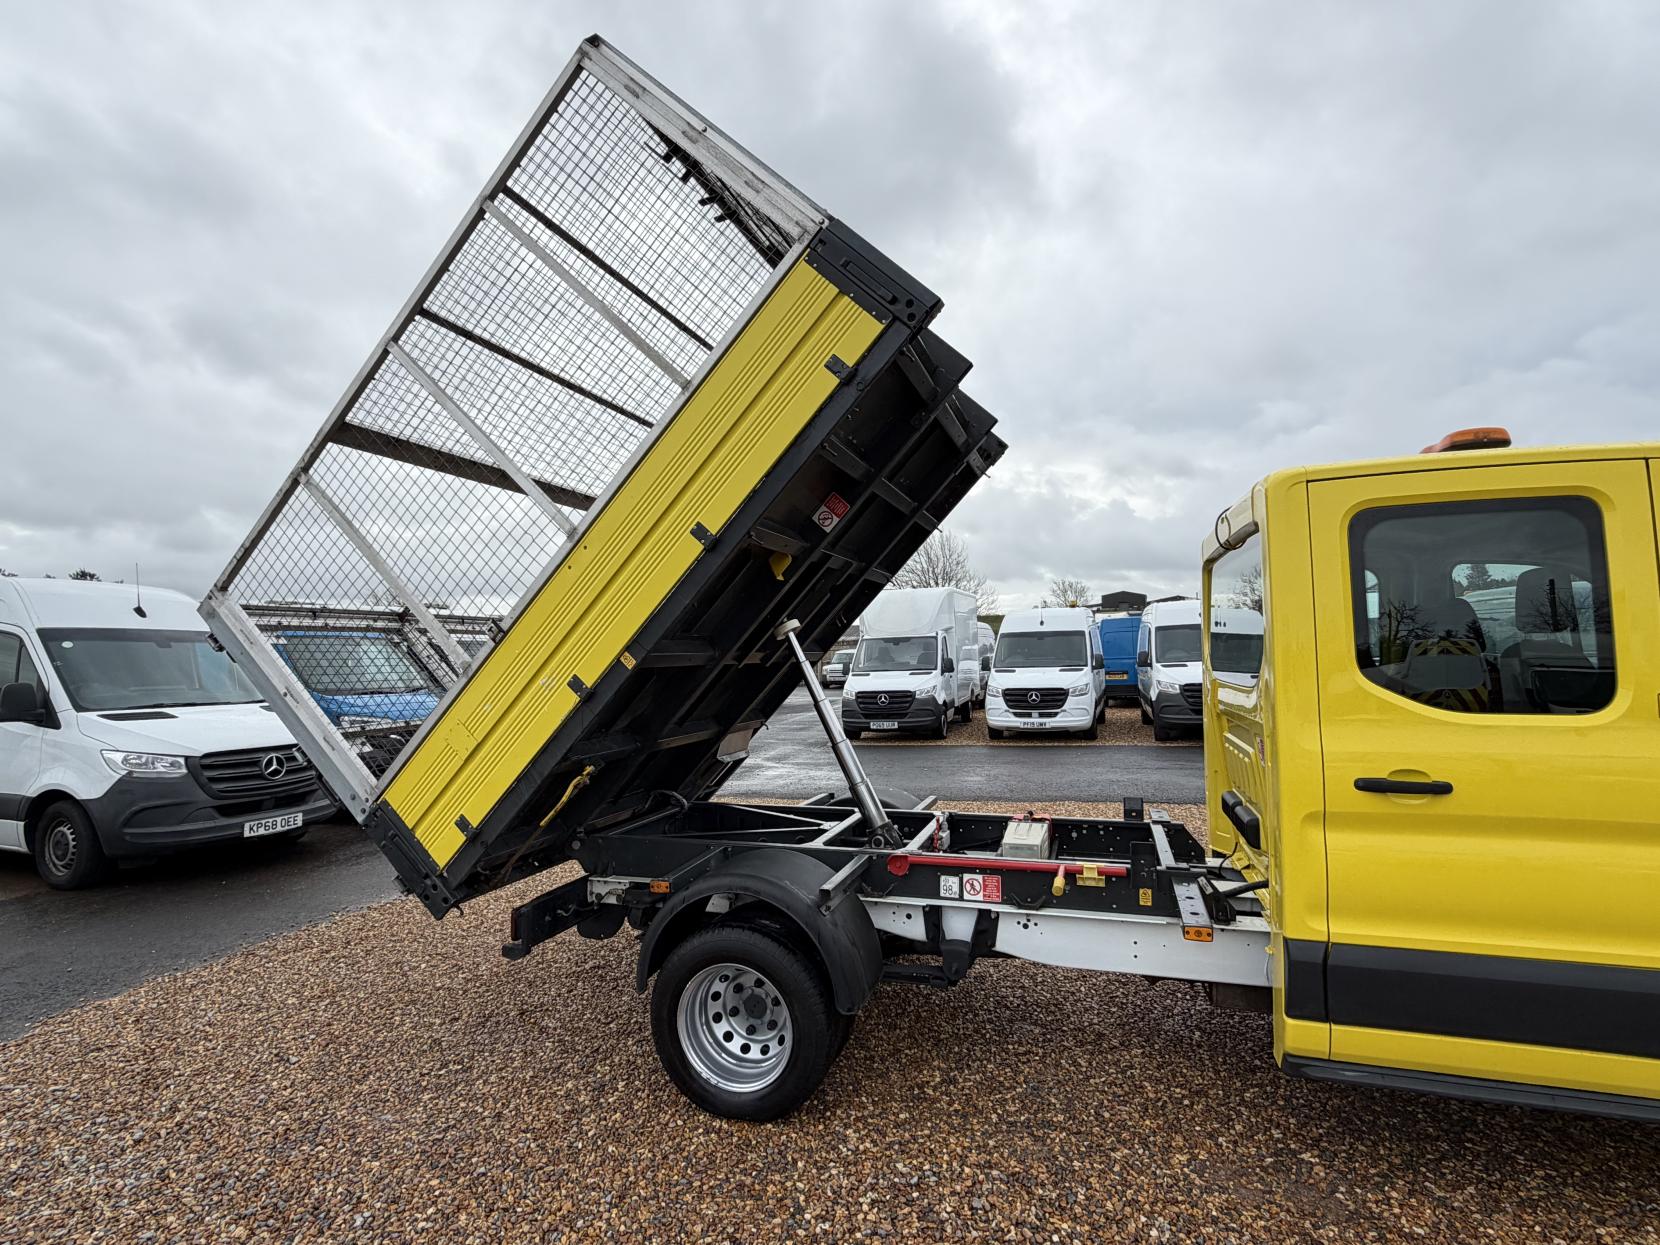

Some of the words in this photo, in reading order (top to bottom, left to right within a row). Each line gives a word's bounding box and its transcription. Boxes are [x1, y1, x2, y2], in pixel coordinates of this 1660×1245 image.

[248, 819, 278, 834] KP68
[280, 815, 299, 829] OEE
[942, 884, 954, 896] 98
